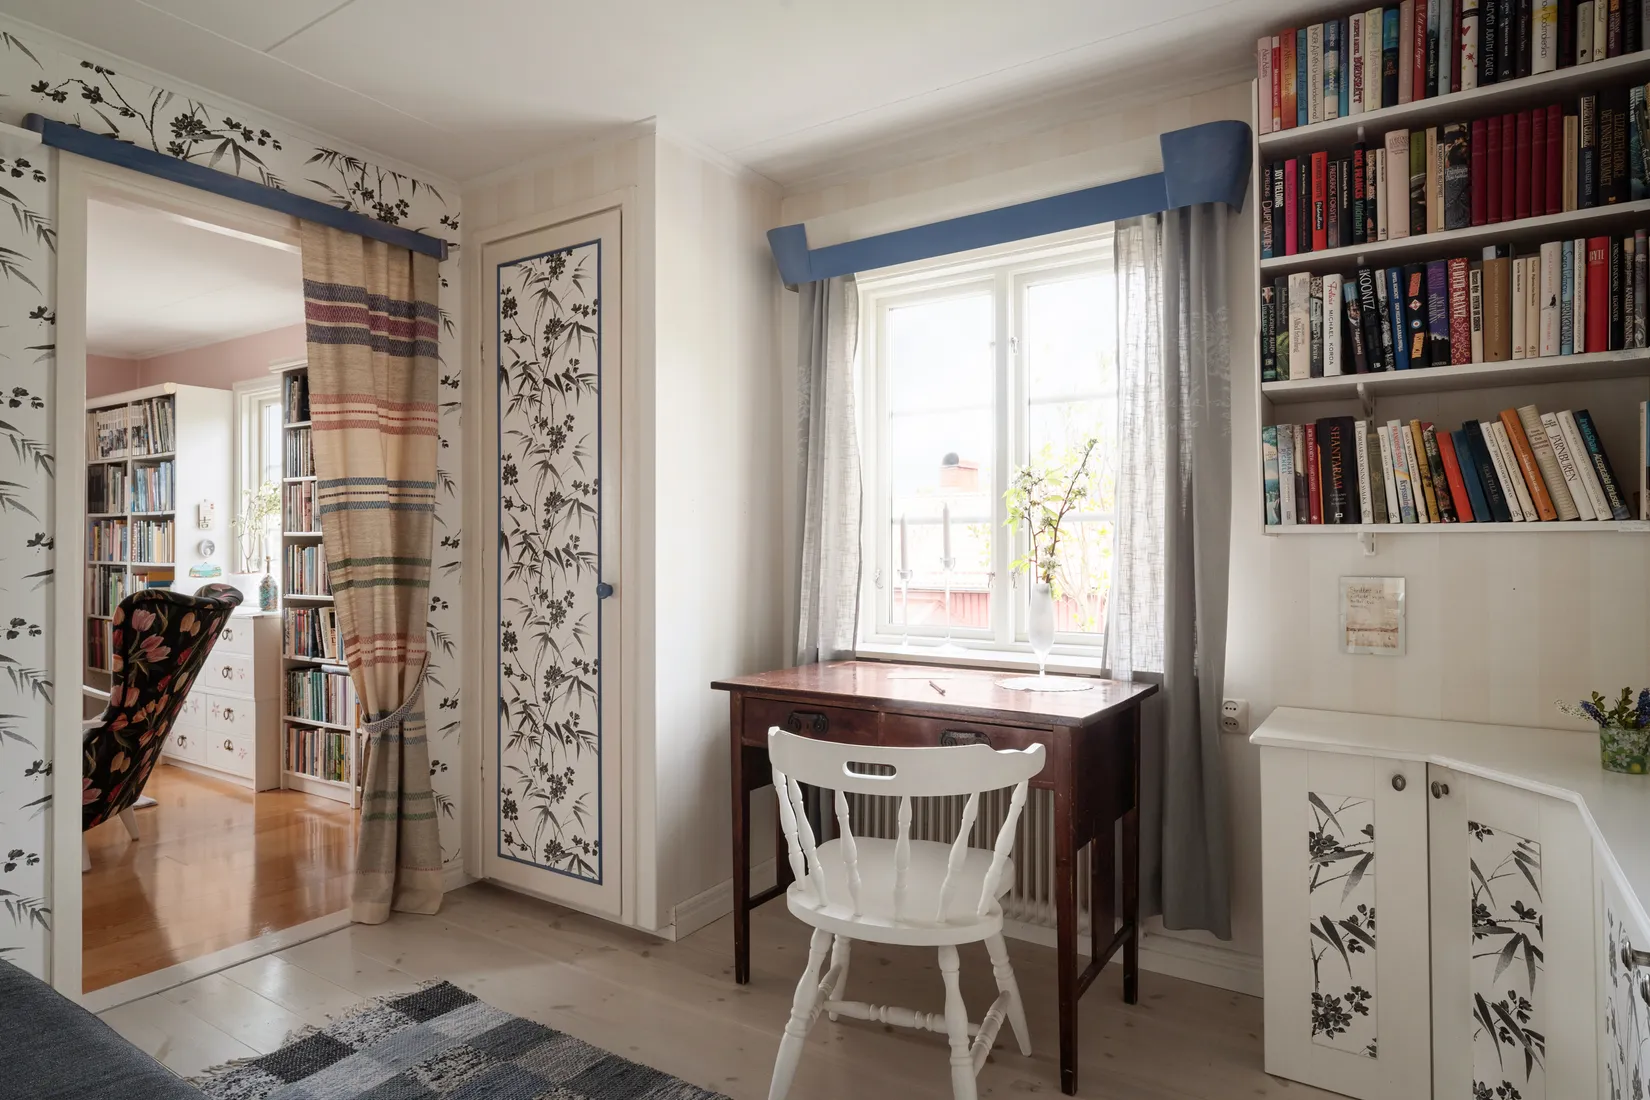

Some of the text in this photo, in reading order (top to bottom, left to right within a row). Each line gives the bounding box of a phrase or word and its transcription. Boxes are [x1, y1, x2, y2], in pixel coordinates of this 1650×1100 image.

[1311, 27, 1319, 45] INGER
[1353, 56, 1364, 104] BÖRDSRÄTT
[1584, 96, 1593, 125] ELIZABETH
[1584, 126, 1592, 147] GEORGE
[1600, 109, 1612, 187] DET INNERSTA RUMMET
[1614, 113, 1625, 178] ELIZABETH GEORGE
[1274, 169, 1283, 208] JOY FIELDING
[1354, 150, 1364, 235] DICK FRANCIS Vildmark
[1359, 273, 1375, 311] KOONTZ
[1562, 250, 1573, 346] Sara Lidman JÄRNKRONAN
[1330, 426, 1343, 489] SHANTARAM
[1549, 435, 1578, 482] JÄRNBUREN
[1579, 418, 1621, 508] Irwin Shaw Acceptabla förluster
